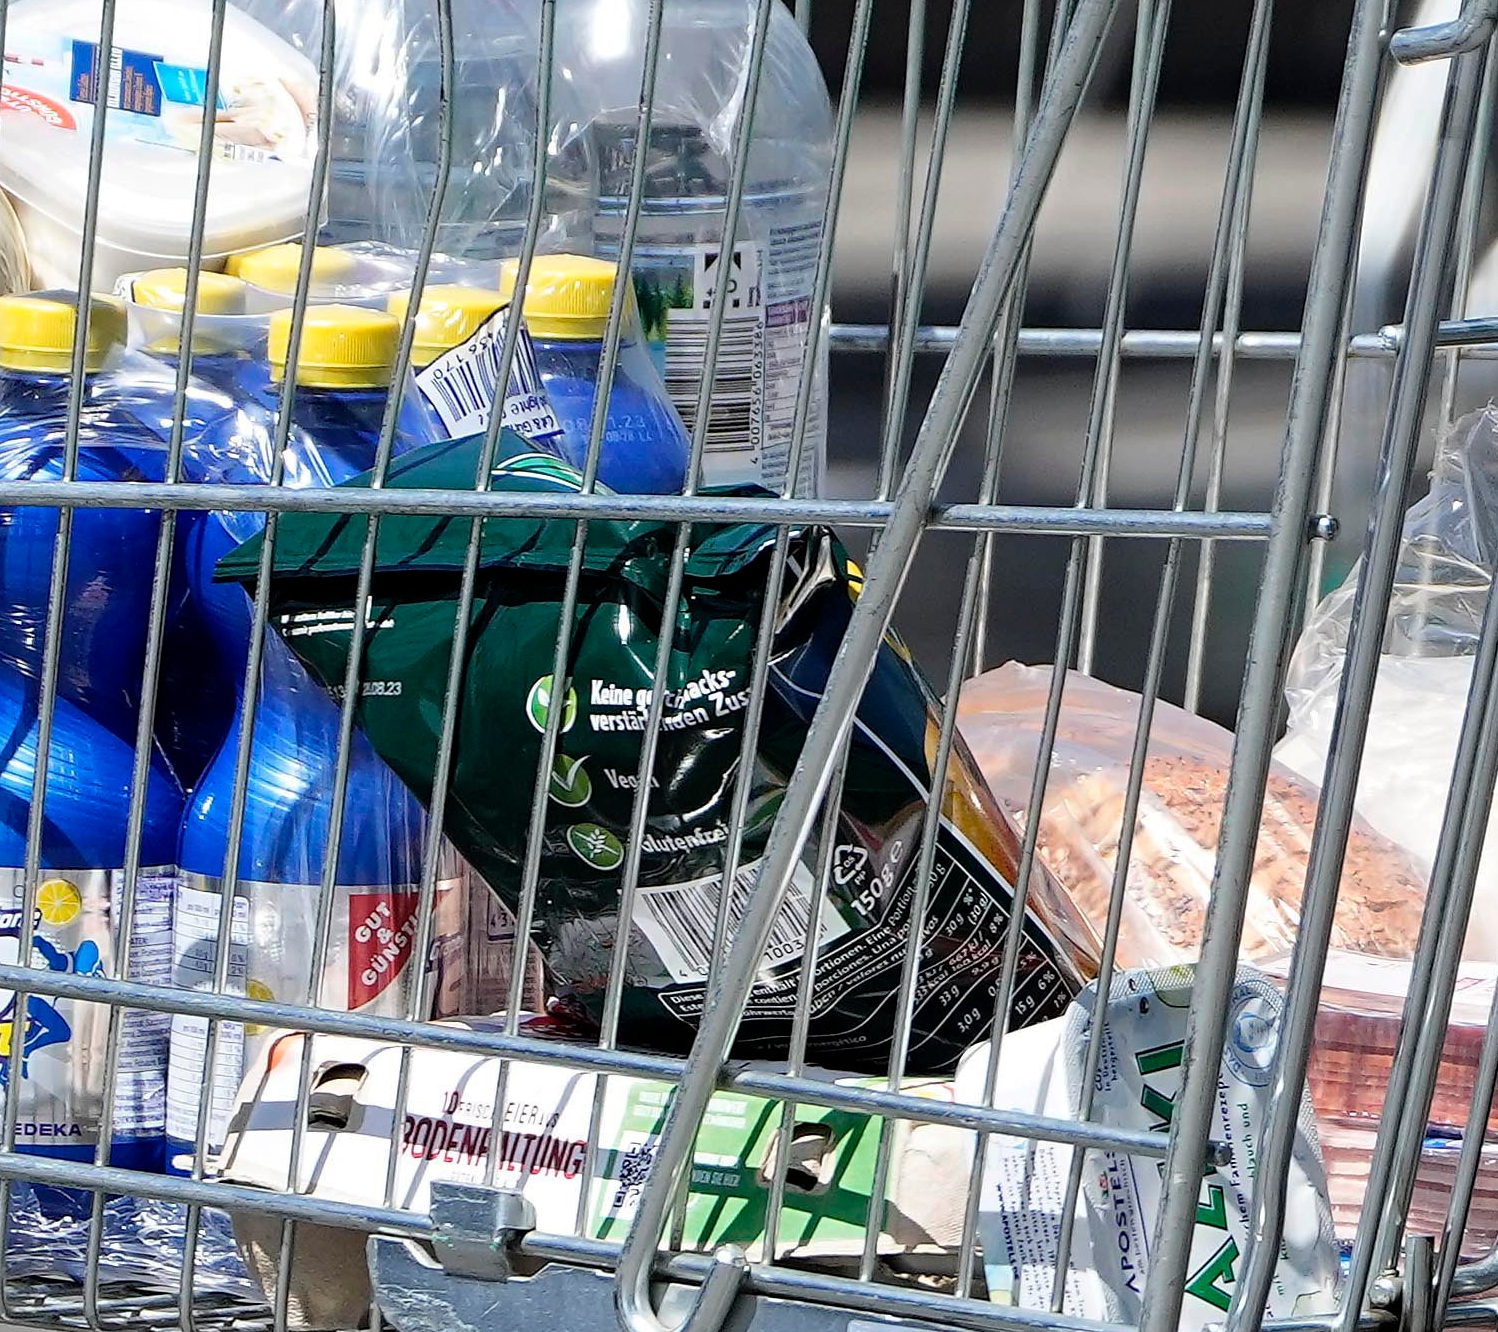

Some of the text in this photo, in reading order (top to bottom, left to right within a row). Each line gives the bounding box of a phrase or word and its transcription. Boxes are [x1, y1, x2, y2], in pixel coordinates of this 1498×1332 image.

[591, 679, 633, 705] Keine
[355, 901, 392, 944] GUT
[377, 926, 395, 945] &
[813, 943, 867, 977] ortionen.
[15, 1123, 83, 1137] EDEKA
